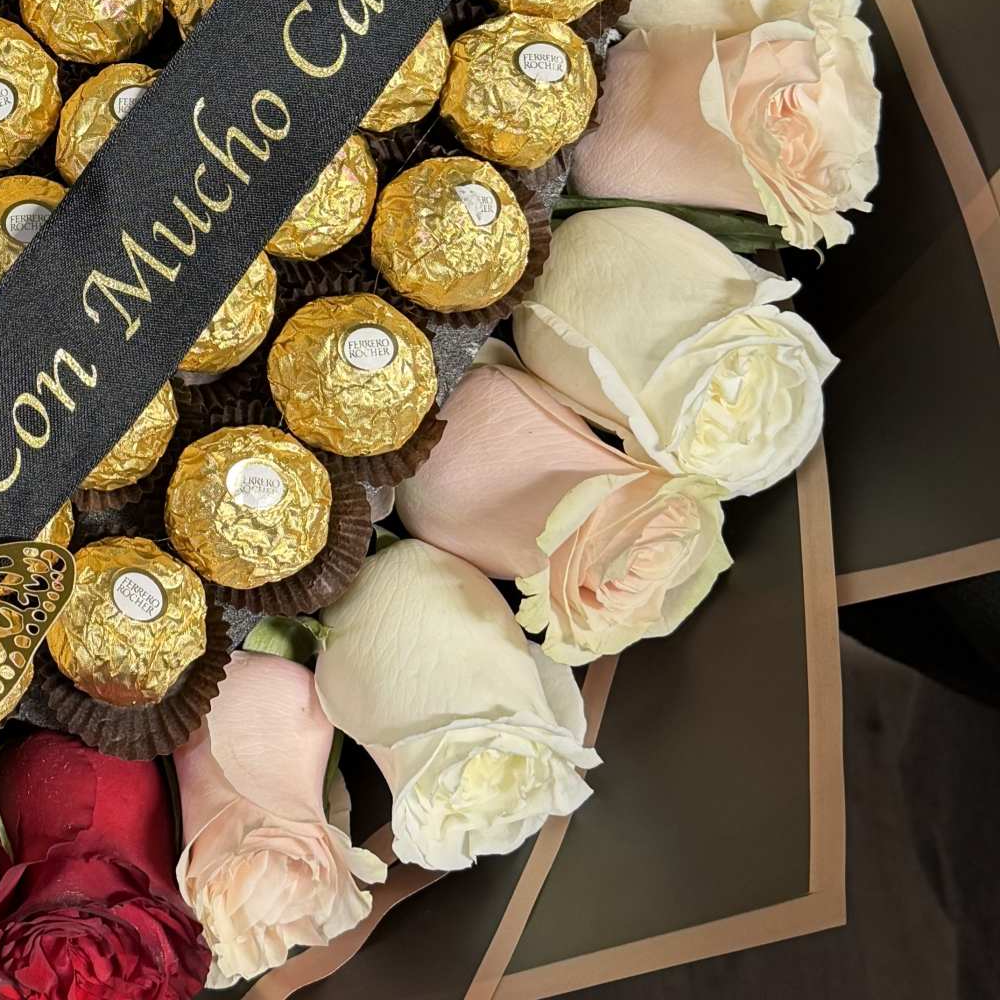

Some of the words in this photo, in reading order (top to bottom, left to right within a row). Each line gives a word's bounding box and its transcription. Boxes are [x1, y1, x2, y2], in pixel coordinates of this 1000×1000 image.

[10, 222, 41, 232] ROCH
[83, 97, 290, 341] Mucho
[348, 340, 389, 350] FERRERO
[117, 585, 154, 615] ROCHER
[122, 577, 160, 608] FERRERO
